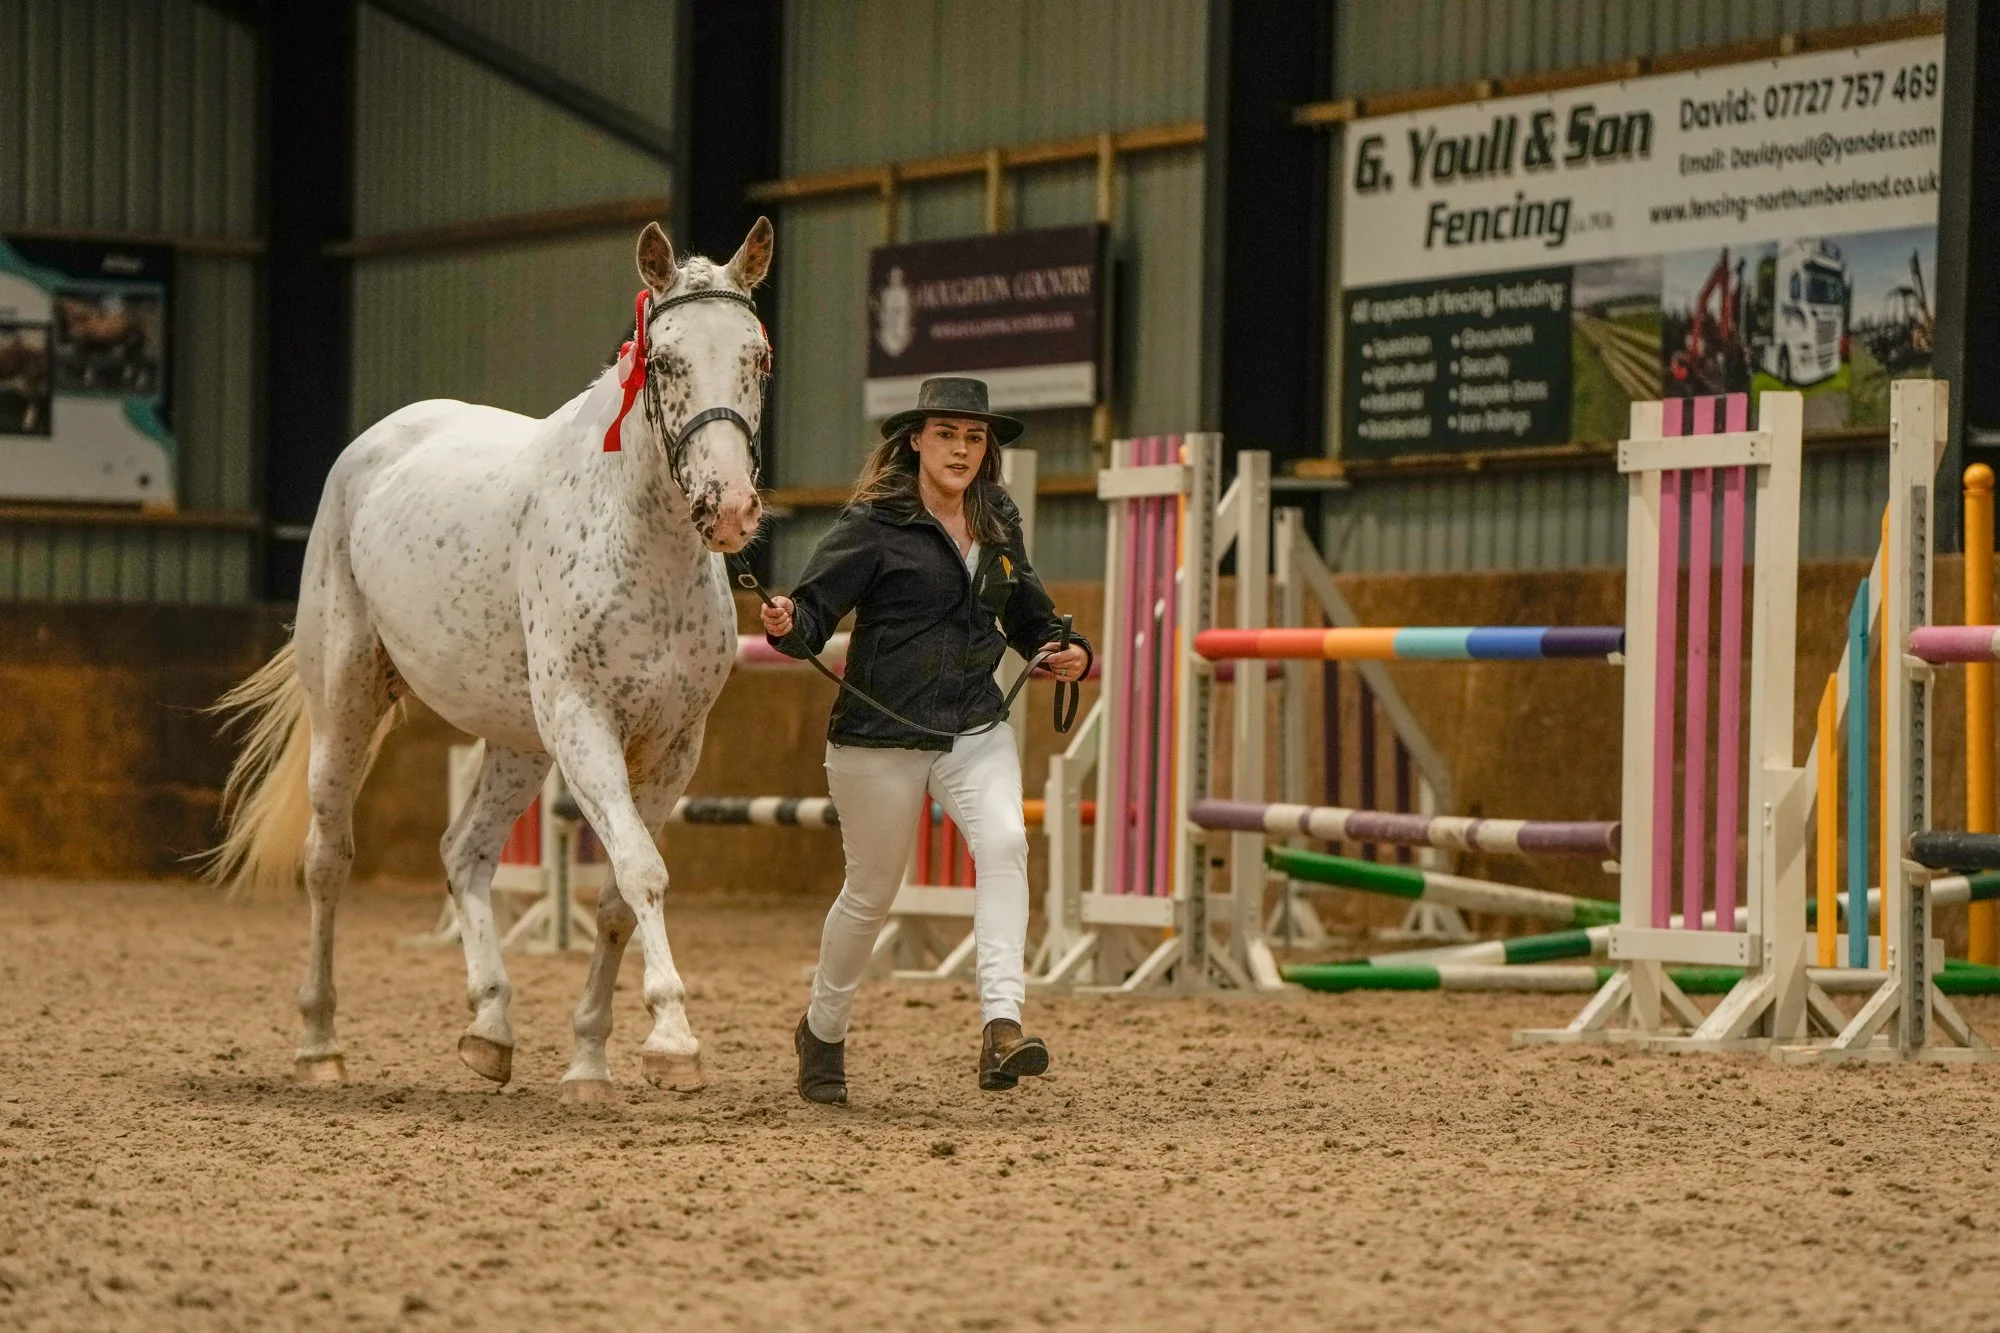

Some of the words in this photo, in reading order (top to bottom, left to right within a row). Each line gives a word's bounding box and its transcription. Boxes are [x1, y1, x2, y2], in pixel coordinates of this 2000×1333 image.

[1679, 87, 1757, 131] David:
[1764, 77, 1834, 119] 07727
[1841, 70, 1885, 110] 757
[1892, 61, 1938, 102] 469
[1354, 134, 1393, 193] G.
[1408, 114, 1518, 186] Youll
[1522, 108, 1555, 172] &
[1562, 102, 1652, 166] Son
[1422, 190, 1572, 249] Fencing
